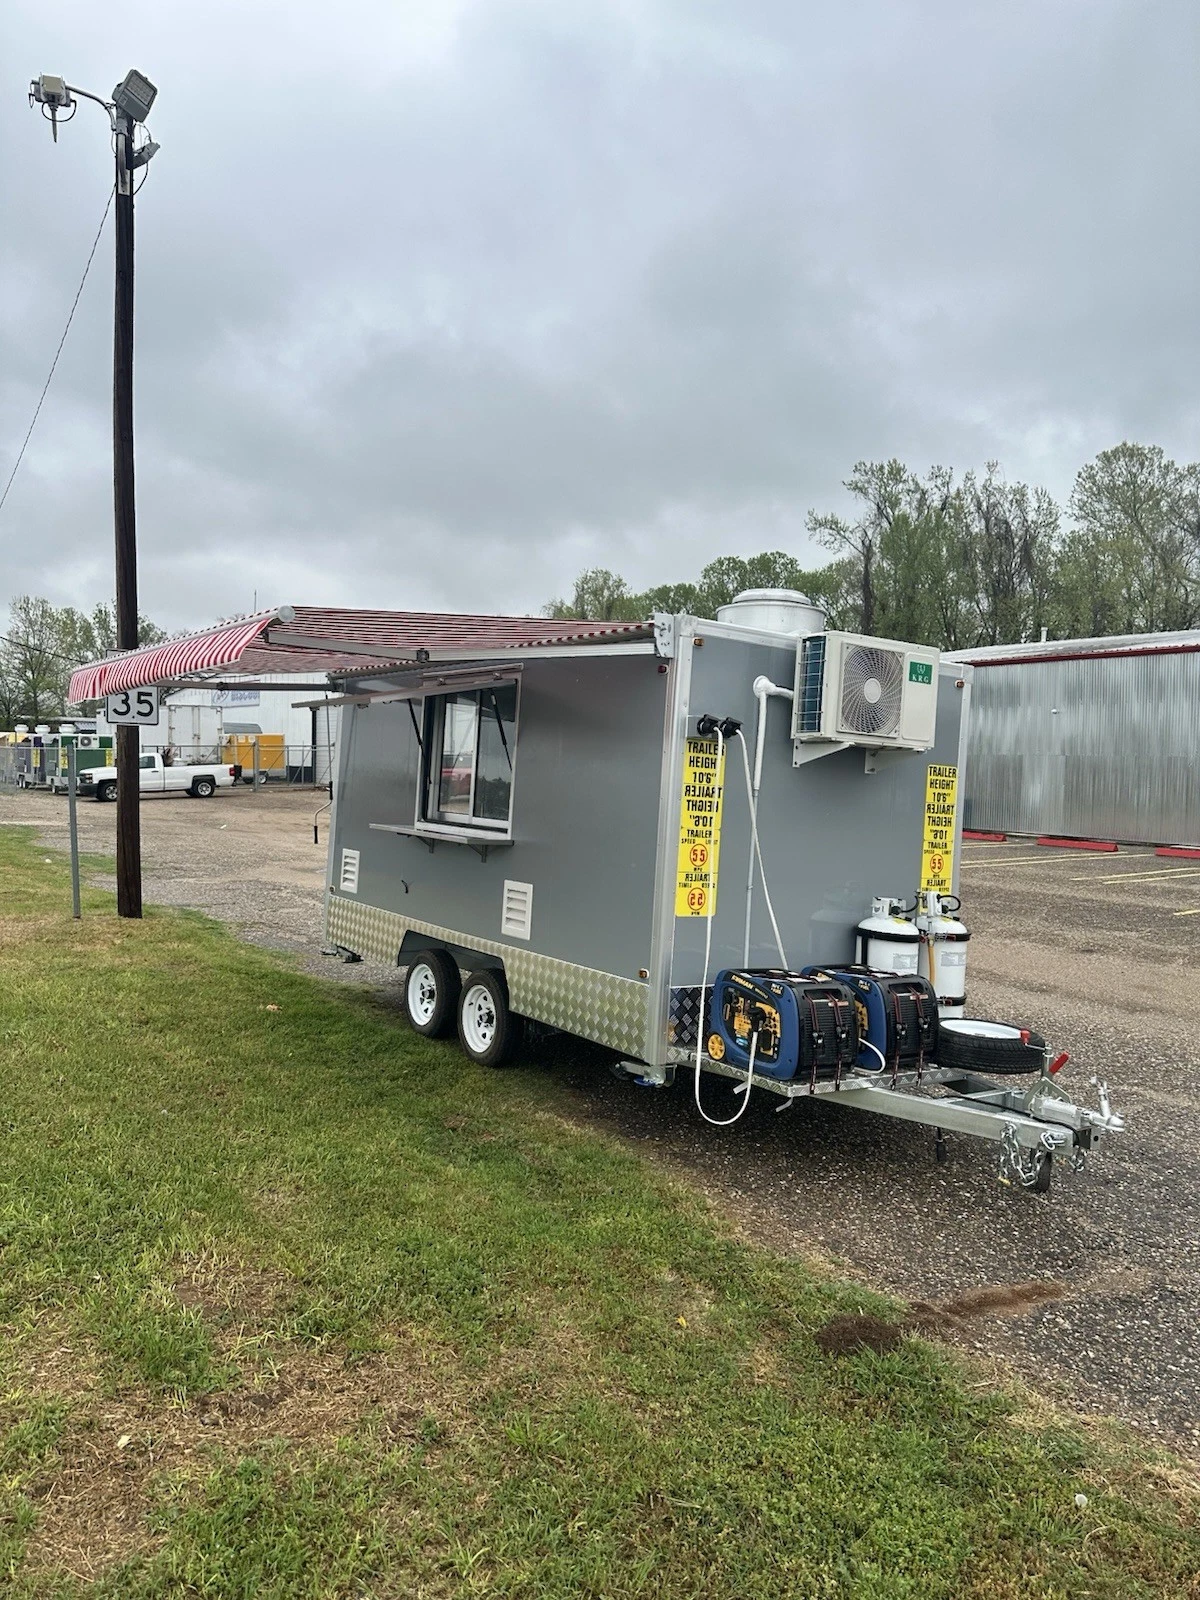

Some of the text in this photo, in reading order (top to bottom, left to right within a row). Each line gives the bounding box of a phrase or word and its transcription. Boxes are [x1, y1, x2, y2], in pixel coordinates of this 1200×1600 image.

[912, 673, 929, 683] KRG
[112, 691, 154, 717] 35
[688, 755, 719, 770] HEIGH
[929, 766, 957, 778] TRAILER
[930, 778, 954, 790] HEIGHT
[687, 829, 712, 838] TRAILER
[928, 841, 948, 849] TRAILER
[692, 848, 706, 862] 55
[931, 858, 942, 870] 55
